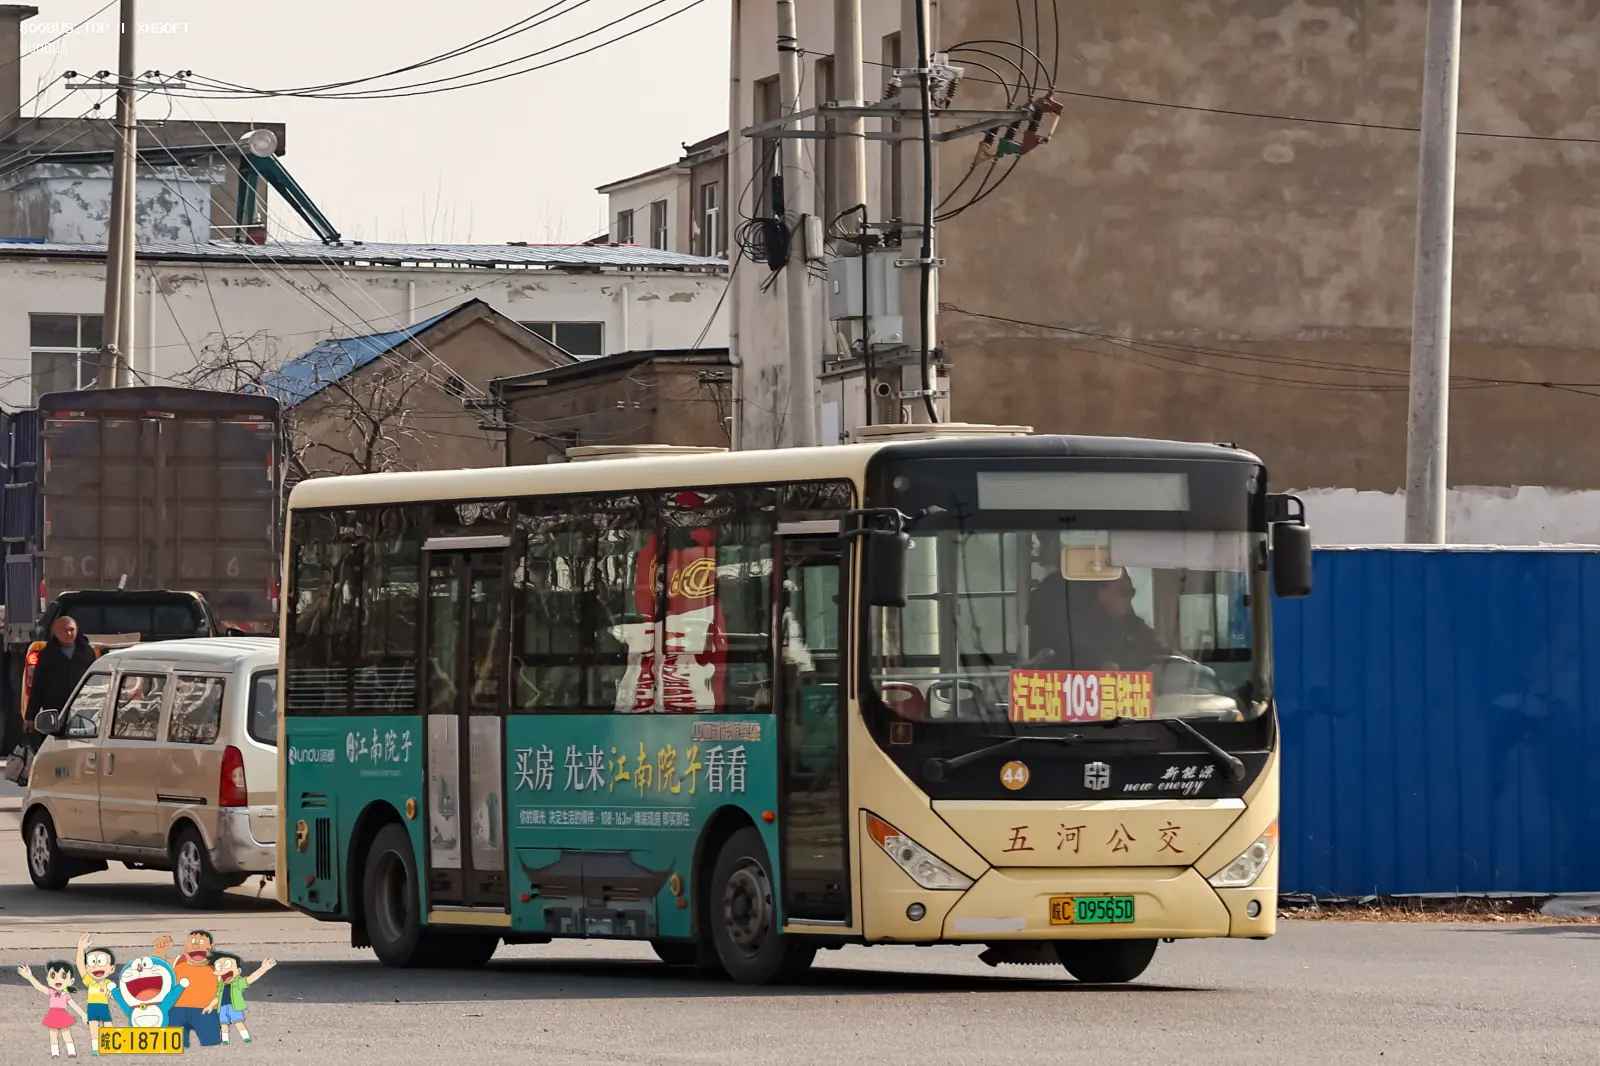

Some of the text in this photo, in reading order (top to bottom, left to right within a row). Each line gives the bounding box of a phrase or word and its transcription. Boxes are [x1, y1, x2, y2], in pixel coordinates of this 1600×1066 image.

[1012, 672, 1151, 722] 汽车站 103 高铁站
[353, 728, 413, 765] 江南院子
[514, 744, 555, 793] 买房
[1002, 767, 1025, 784] 44
[1159, 764, 1216, 780] 新能源
[1122, 780, 1205, 796] new energy
[1001, 820, 1185, 854] 五河公交
